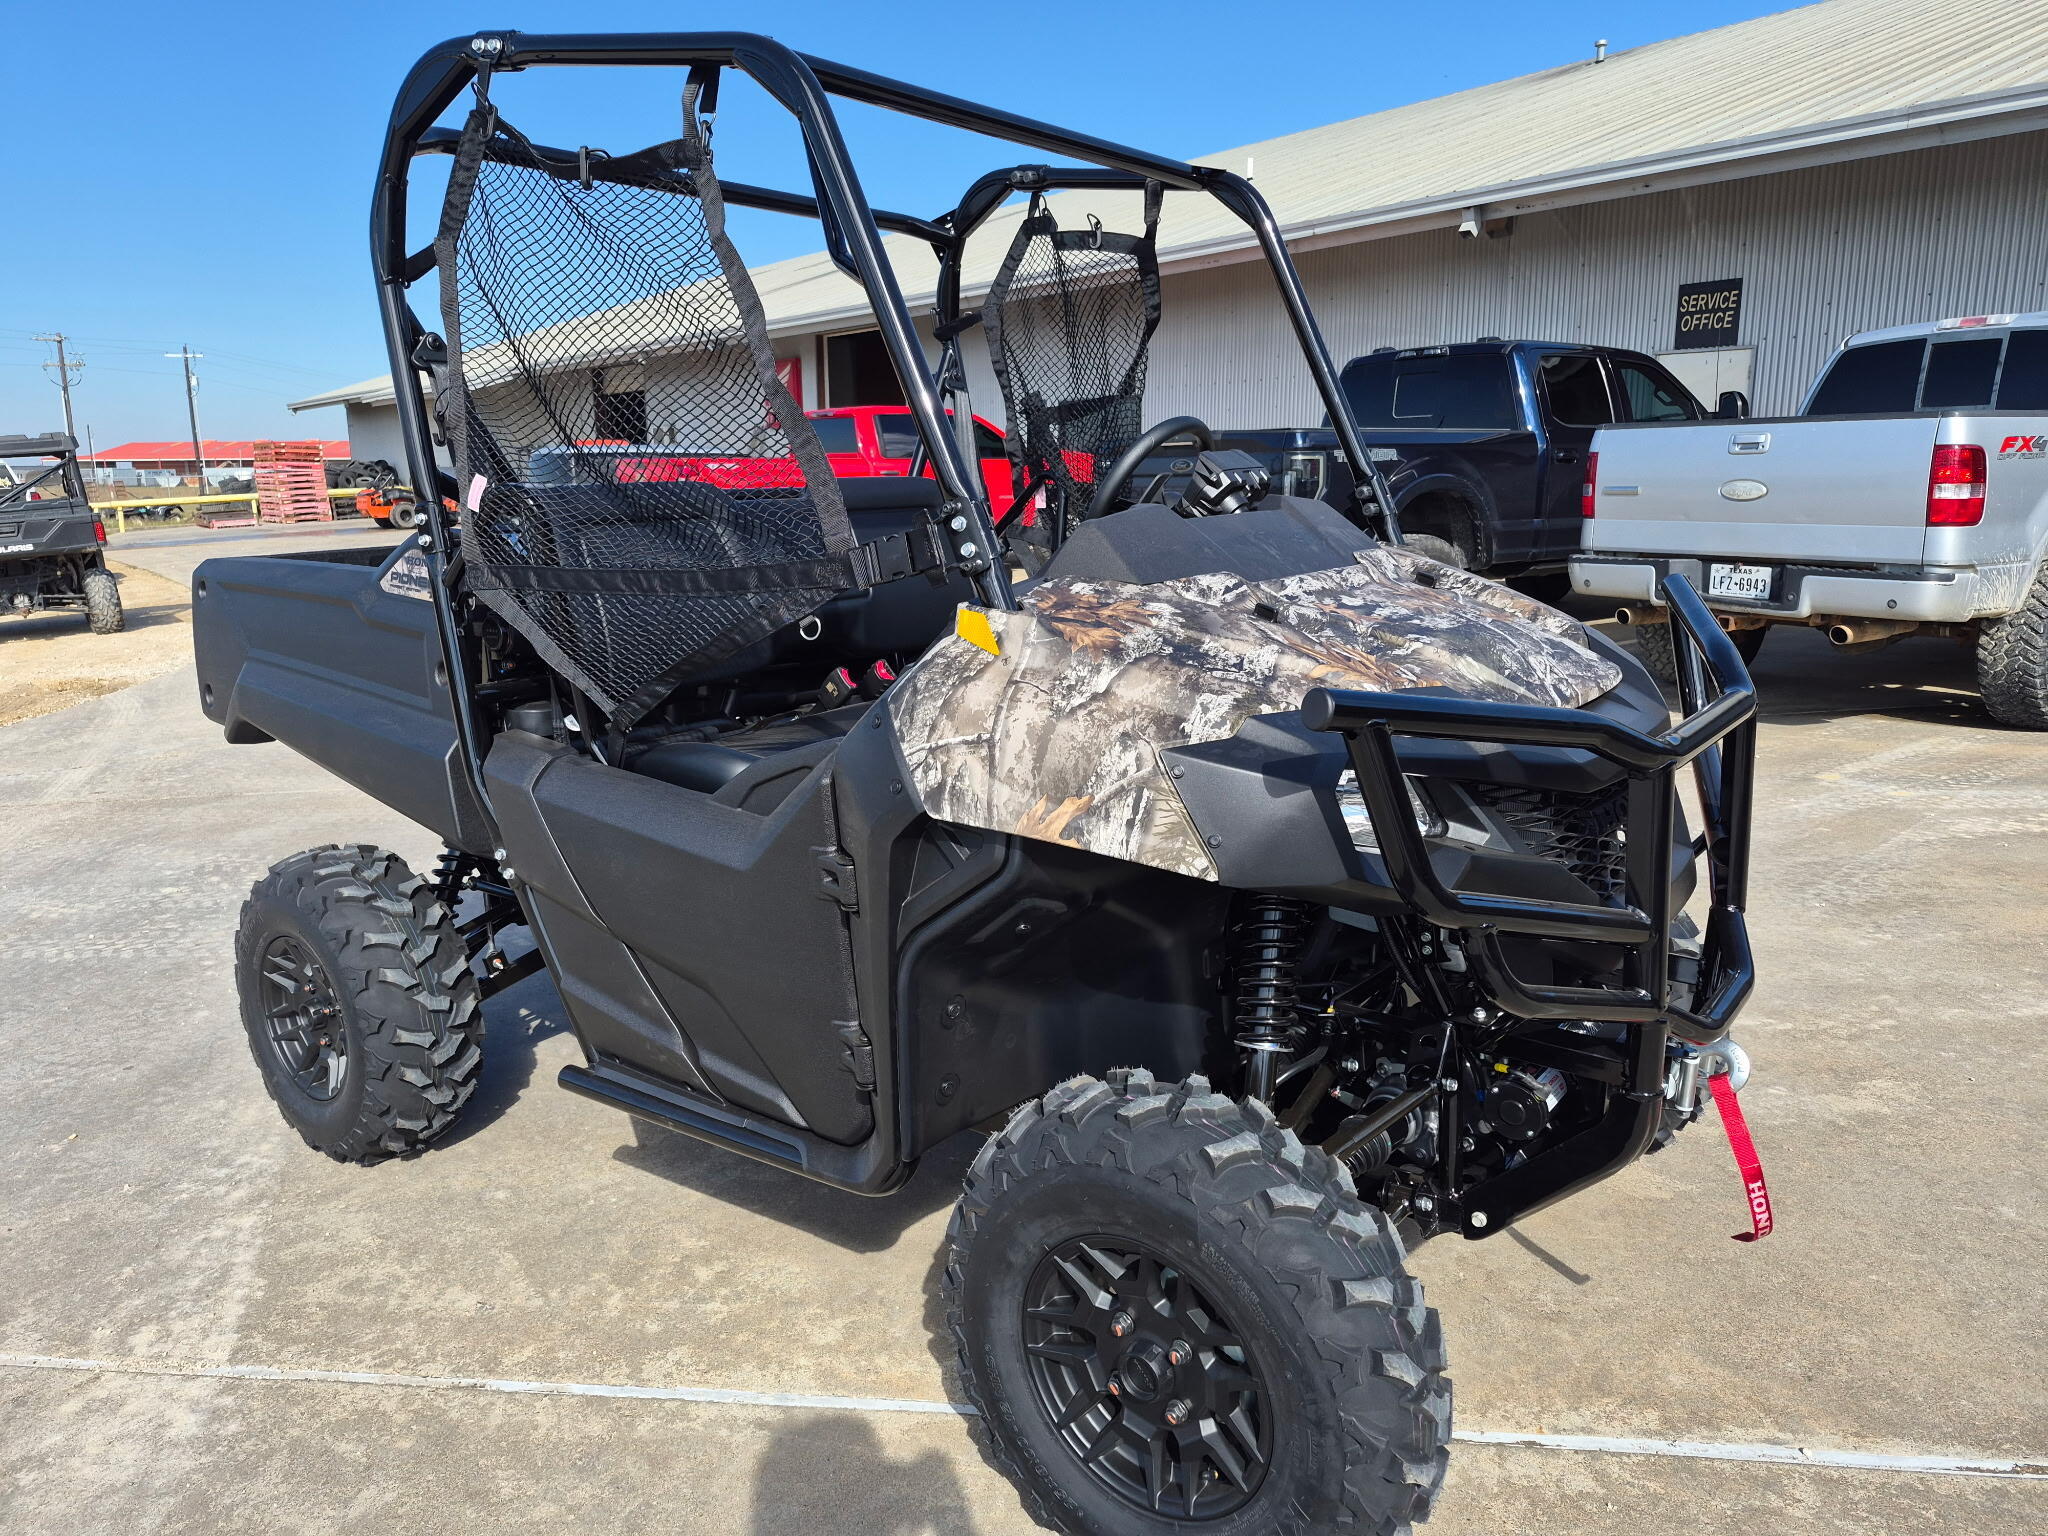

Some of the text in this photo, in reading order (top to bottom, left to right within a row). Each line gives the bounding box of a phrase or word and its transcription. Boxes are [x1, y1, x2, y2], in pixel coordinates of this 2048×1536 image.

[1680, 290, 1739, 312] SERVICE
[1681, 311, 1734, 332] OFFICE
[1999, 435, 2048, 453] FX4
[0, 543, 34, 554] LARIS
[390, 570, 430, 588] PIONE
[1729, 567, 1753, 575] TEXAS
[1748, 1180, 1771, 1239] HOND
